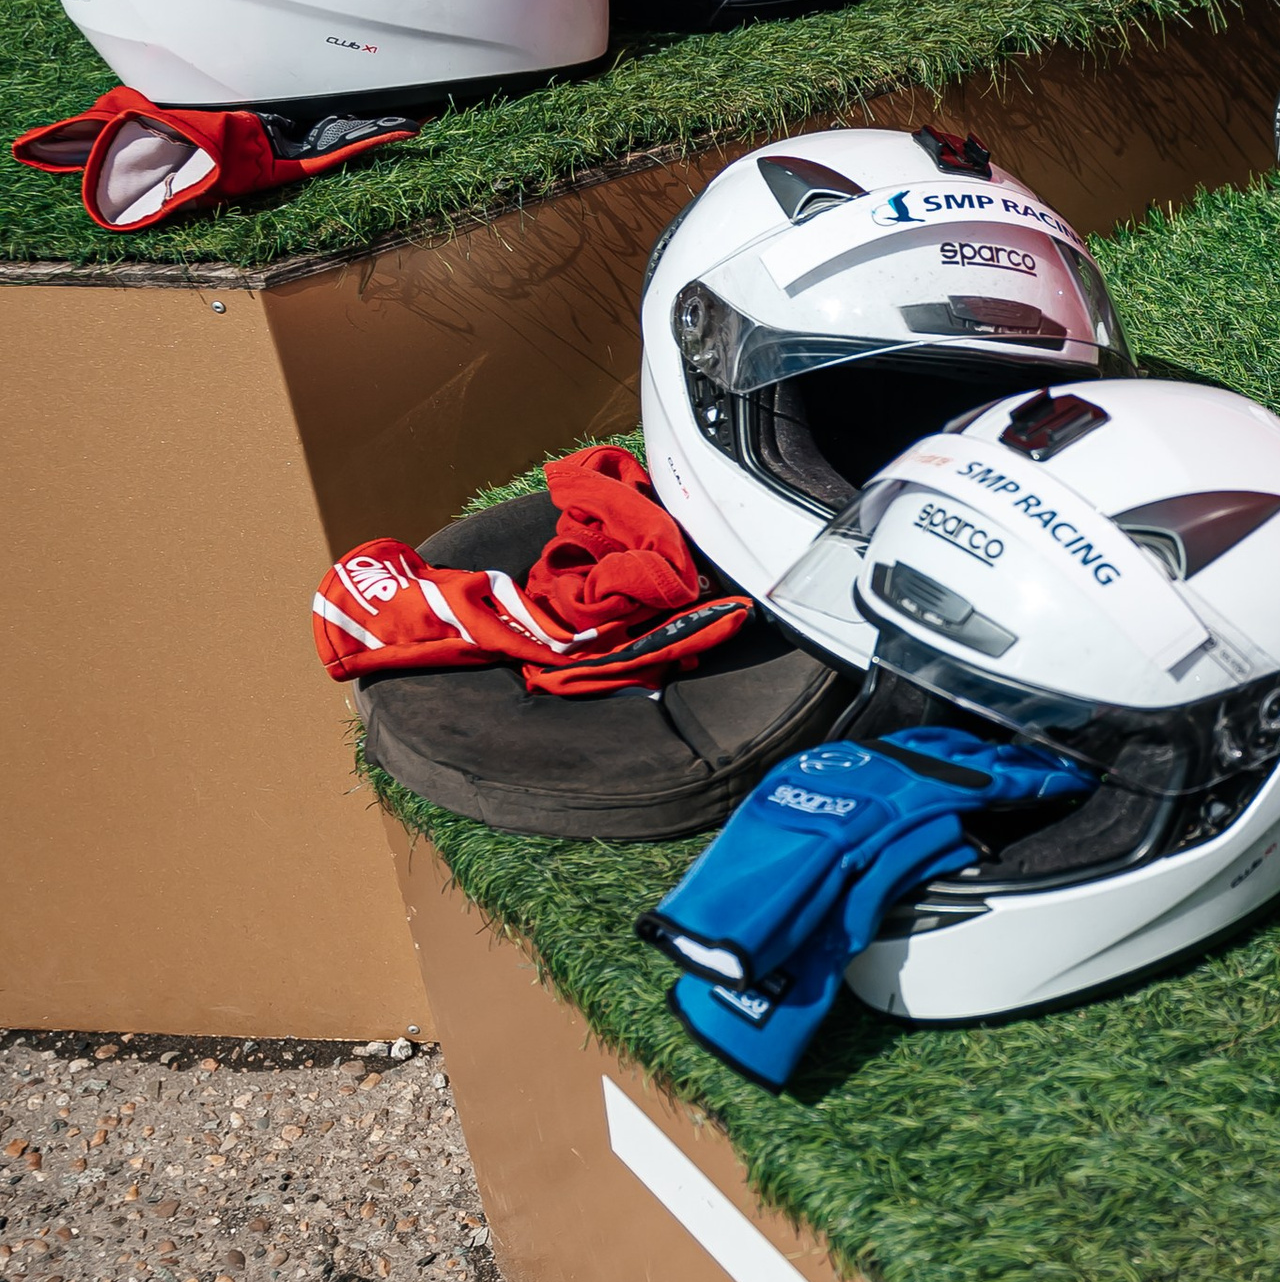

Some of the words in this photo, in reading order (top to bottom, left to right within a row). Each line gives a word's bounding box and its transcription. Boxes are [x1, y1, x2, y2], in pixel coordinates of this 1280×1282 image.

[923, 194, 994, 212] SMP
[939, 242, 1037, 274] sparco
[915, 503, 1005, 564] sparco
[957, 461, 1020, 493] SMP
[1013, 494, 1122, 587] RACING
